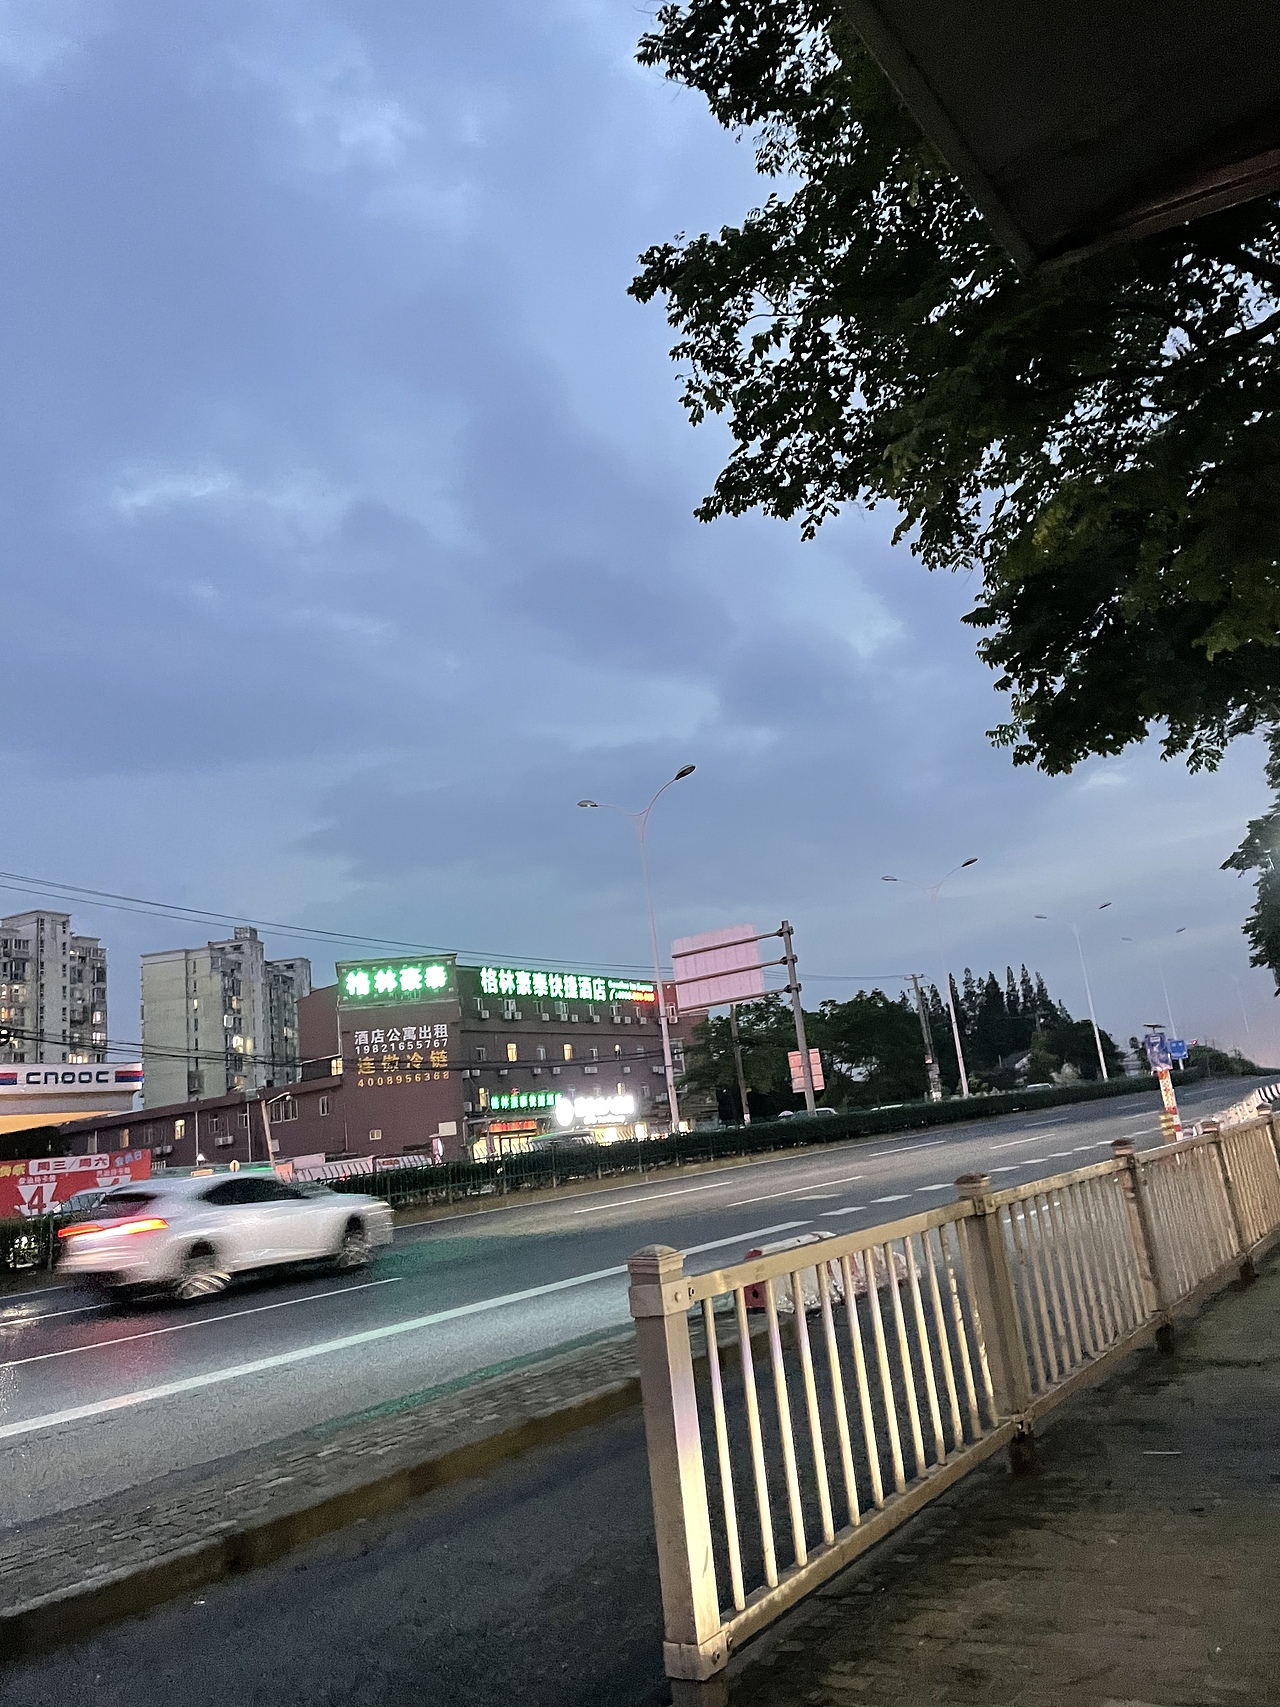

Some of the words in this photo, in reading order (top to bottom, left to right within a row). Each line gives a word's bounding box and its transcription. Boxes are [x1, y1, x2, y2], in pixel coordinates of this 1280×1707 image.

[480, 967, 606, 1001] 格林豪泰快捷酒店
[354, 1023, 448, 1045] 酒店公寓出租
[355, 1038, 448, 1055] 19821655767
[358, 1070, 450, 1088] 4008956368
